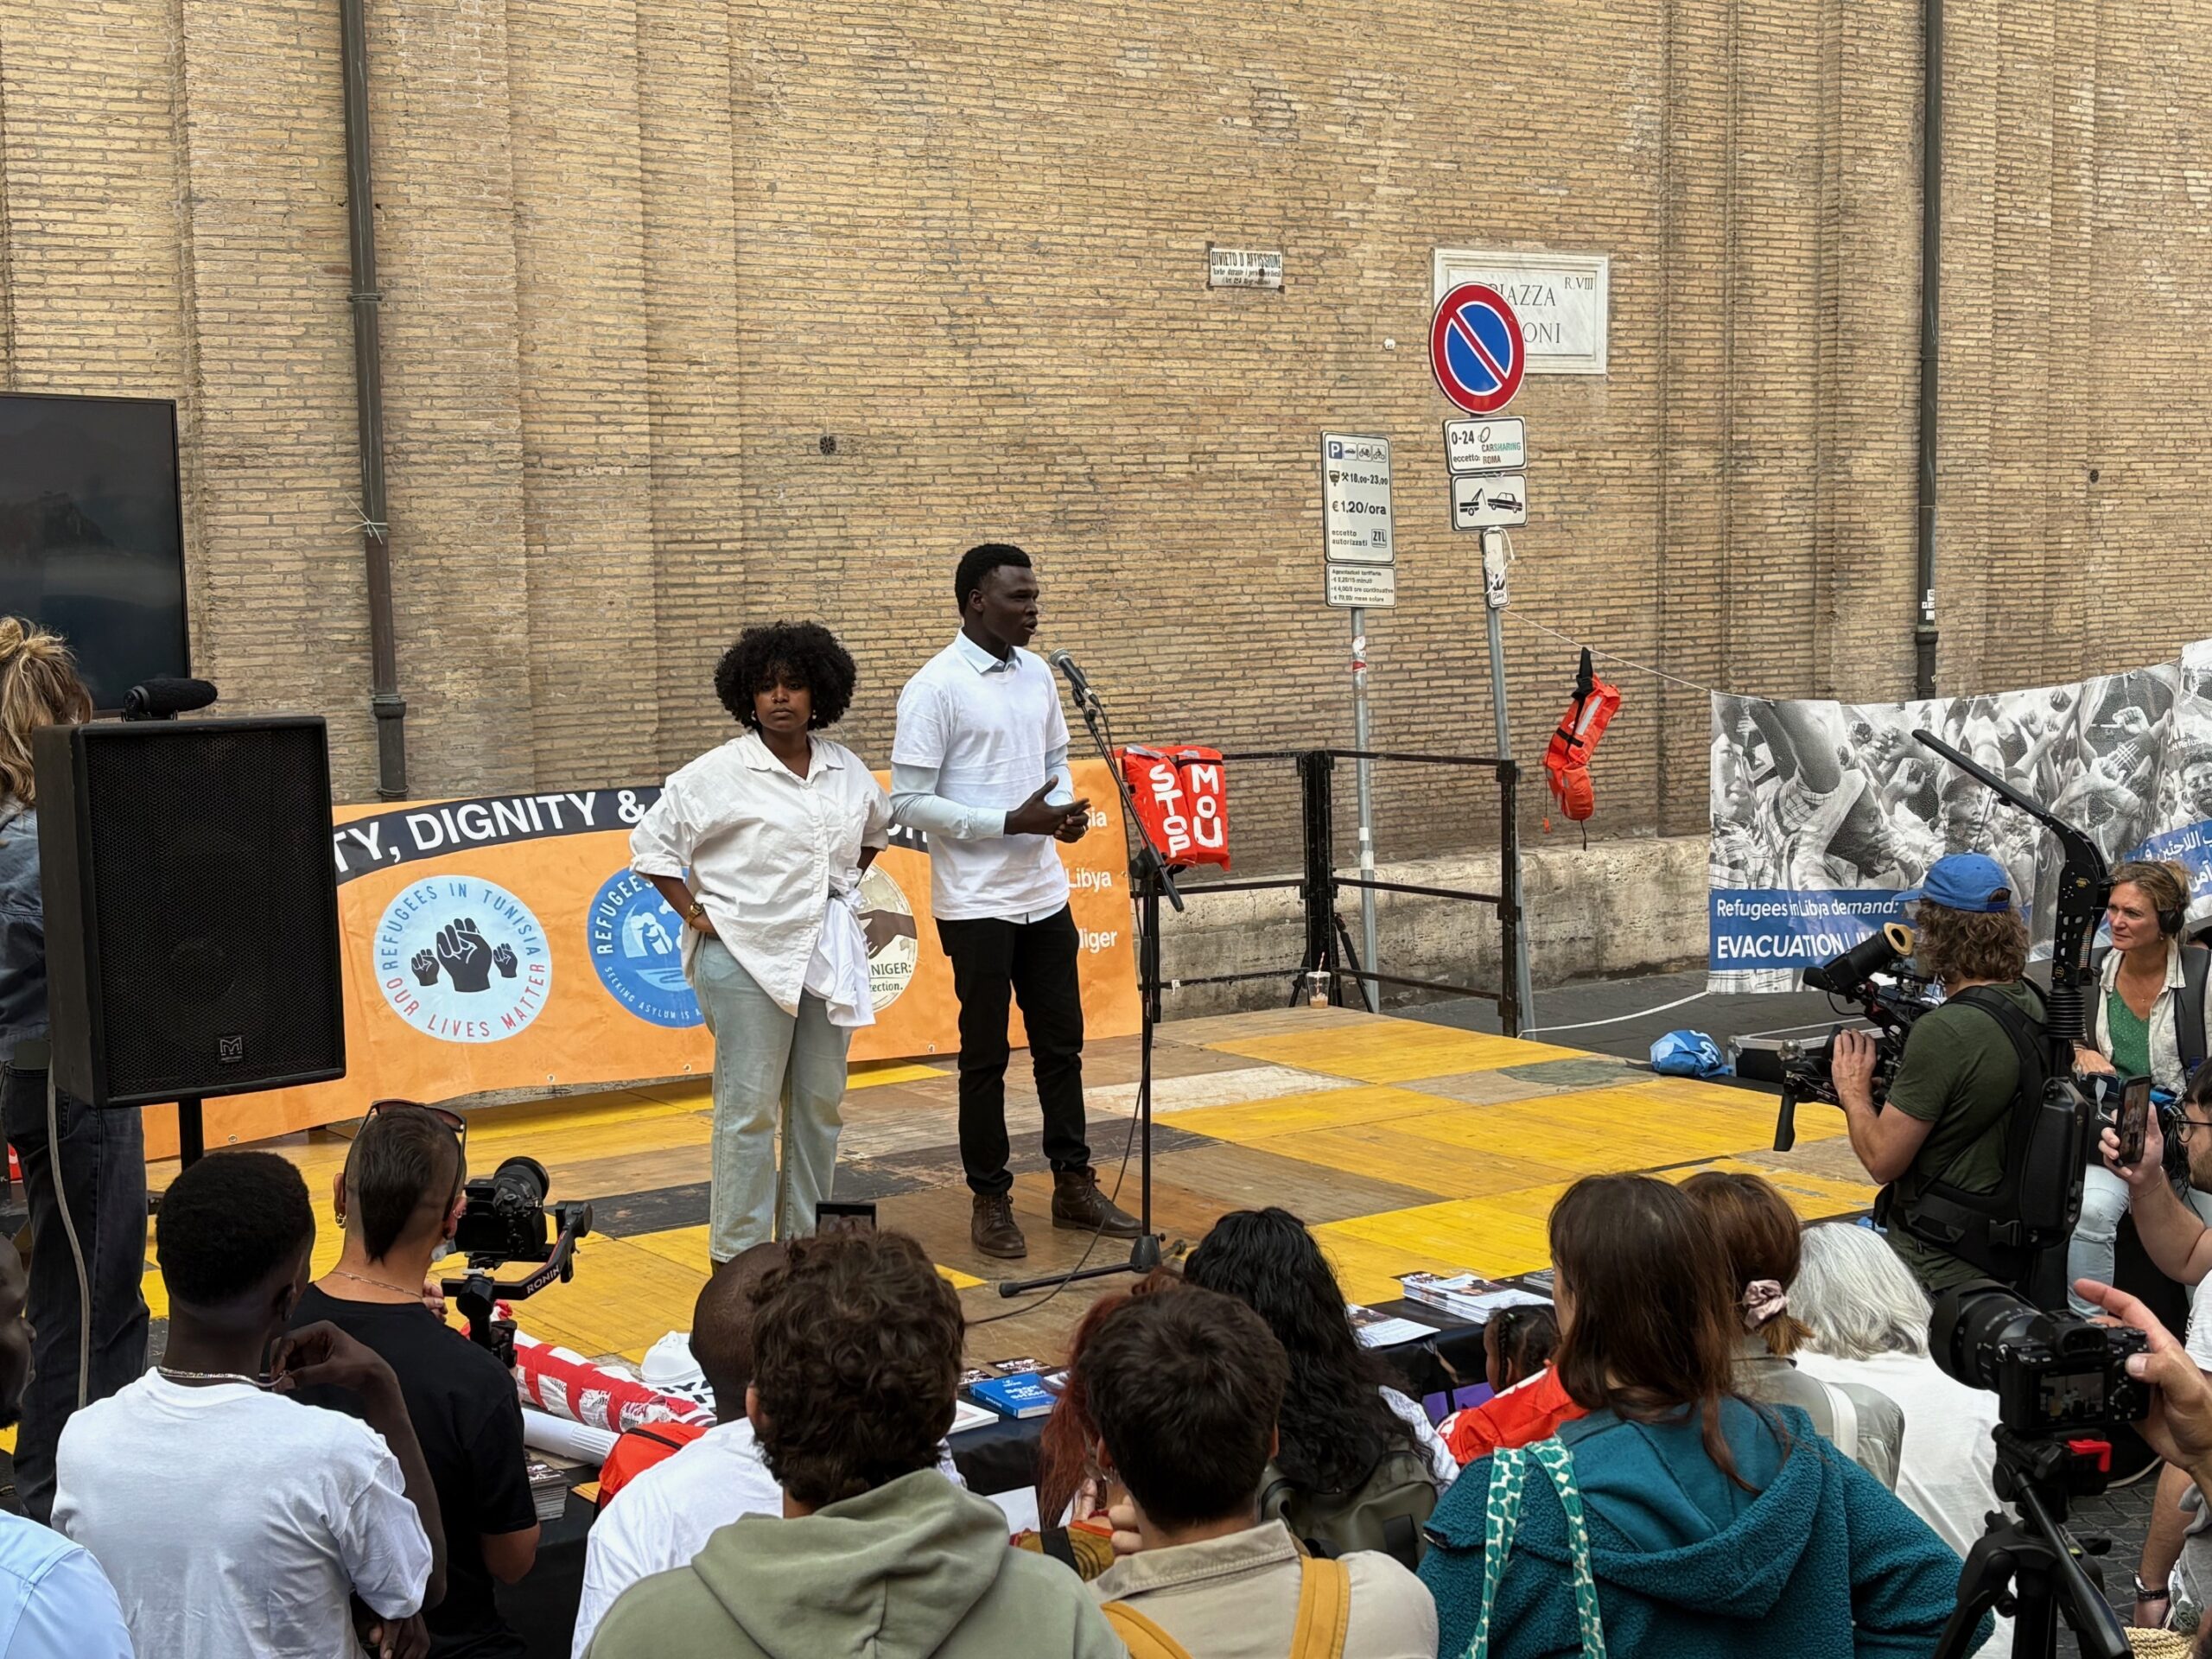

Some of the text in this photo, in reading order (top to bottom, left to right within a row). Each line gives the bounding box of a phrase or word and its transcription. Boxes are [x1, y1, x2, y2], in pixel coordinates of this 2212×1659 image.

[1452, 430, 1474, 445] 0-24
[1482, 442, 1521, 452] CARSHARING
[1453, 454, 1481, 462] eccetto:
[1373, 531, 1386, 543] ZTL
[406, 791, 596, 851] DIGNITY
[618, 789, 646, 823] &
[1148, 763, 1192, 859] STOP
[1066, 868, 1112, 893] Libya
[1717, 899, 1898, 921] Refugees in Libya demand:
[382, 882, 542, 971] REFUGEES IN TUNISIA
[1717, 932, 1843, 959] EVACUATION
[871, 962, 912, 976] NIGER:
[385, 963, 546, 1038] OUR LIVES MATTER
[604, 966, 636, 1003] SEEKING
[639, 1001, 677, 1019] ASYLUM
[526, 1264, 561, 1294] RONIN
